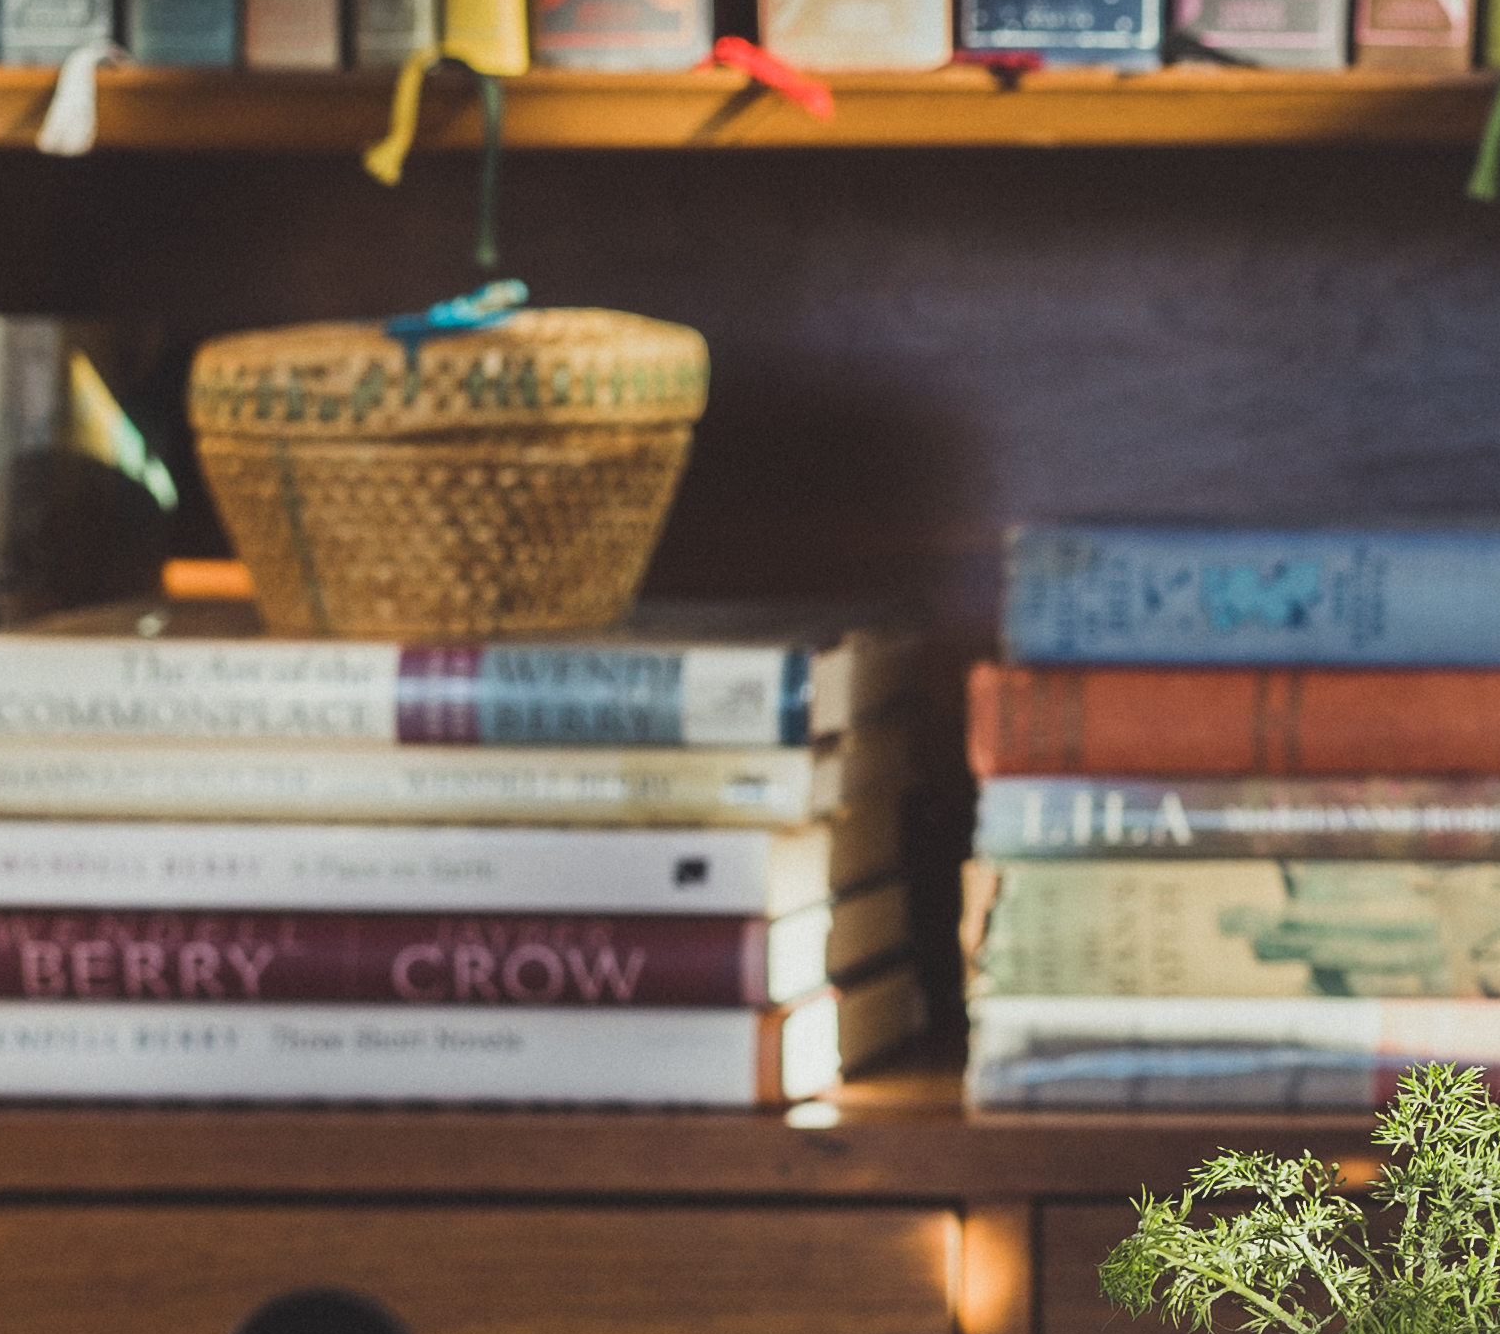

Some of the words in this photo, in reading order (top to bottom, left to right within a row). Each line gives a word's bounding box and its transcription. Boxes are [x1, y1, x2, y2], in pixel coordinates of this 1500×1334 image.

[1021, 788, 1194, 848] LILA
[17, 938, 276, 999] BERRY
[390, 942, 648, 1003] CROW
